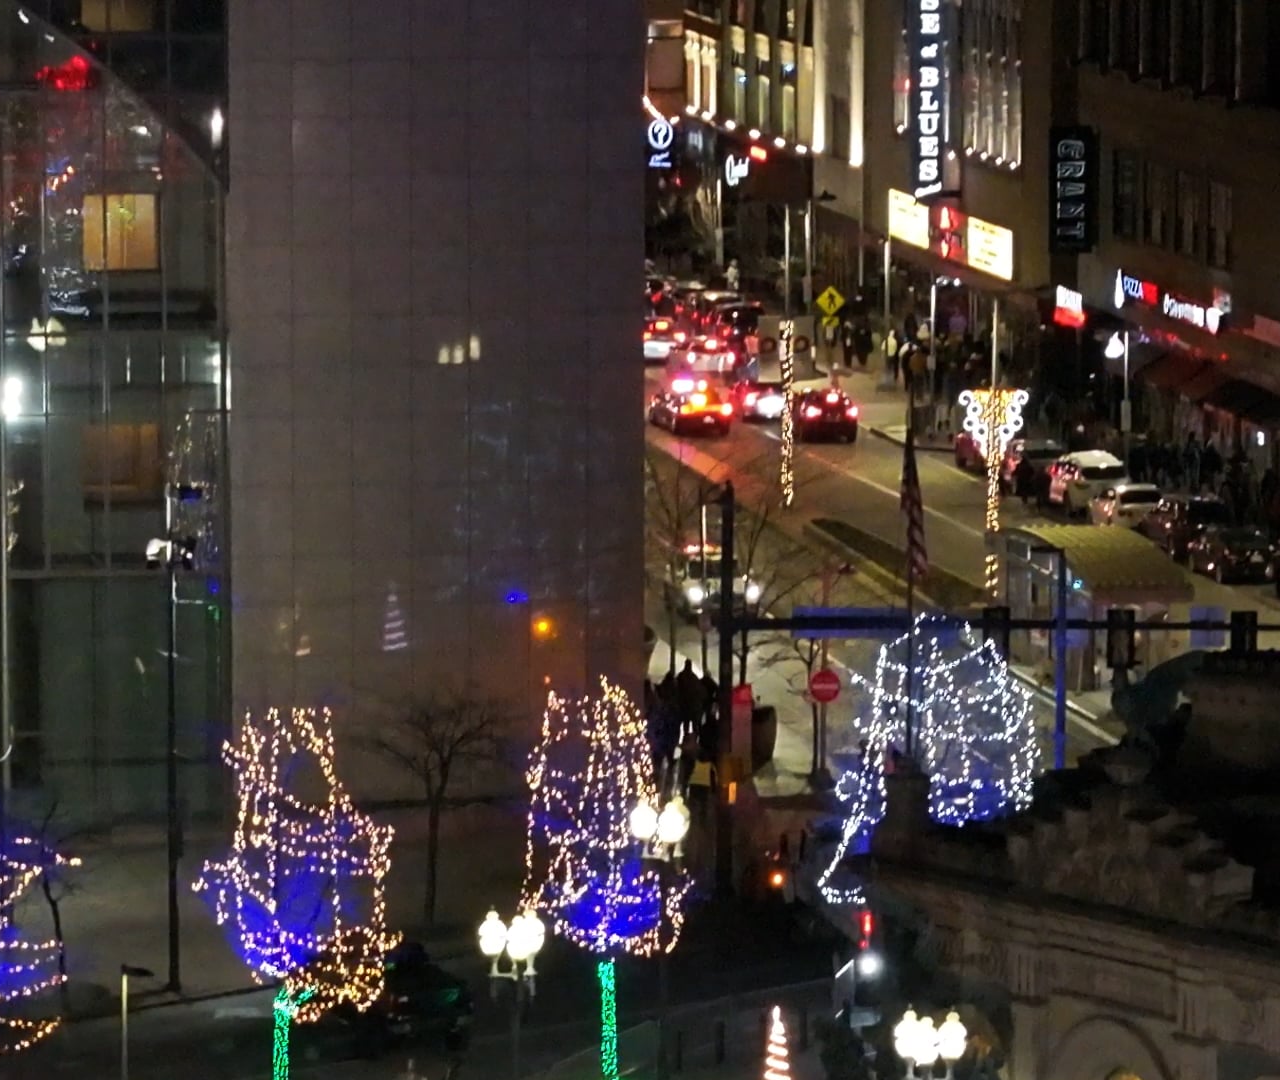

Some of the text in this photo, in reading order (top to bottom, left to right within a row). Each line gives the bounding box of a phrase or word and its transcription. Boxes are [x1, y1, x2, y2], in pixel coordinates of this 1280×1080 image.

[918, 66, 941, 182] BLUES
[1056, 139, 1087, 240] GRANT
[1123, 275, 1145, 300] PIZZA
